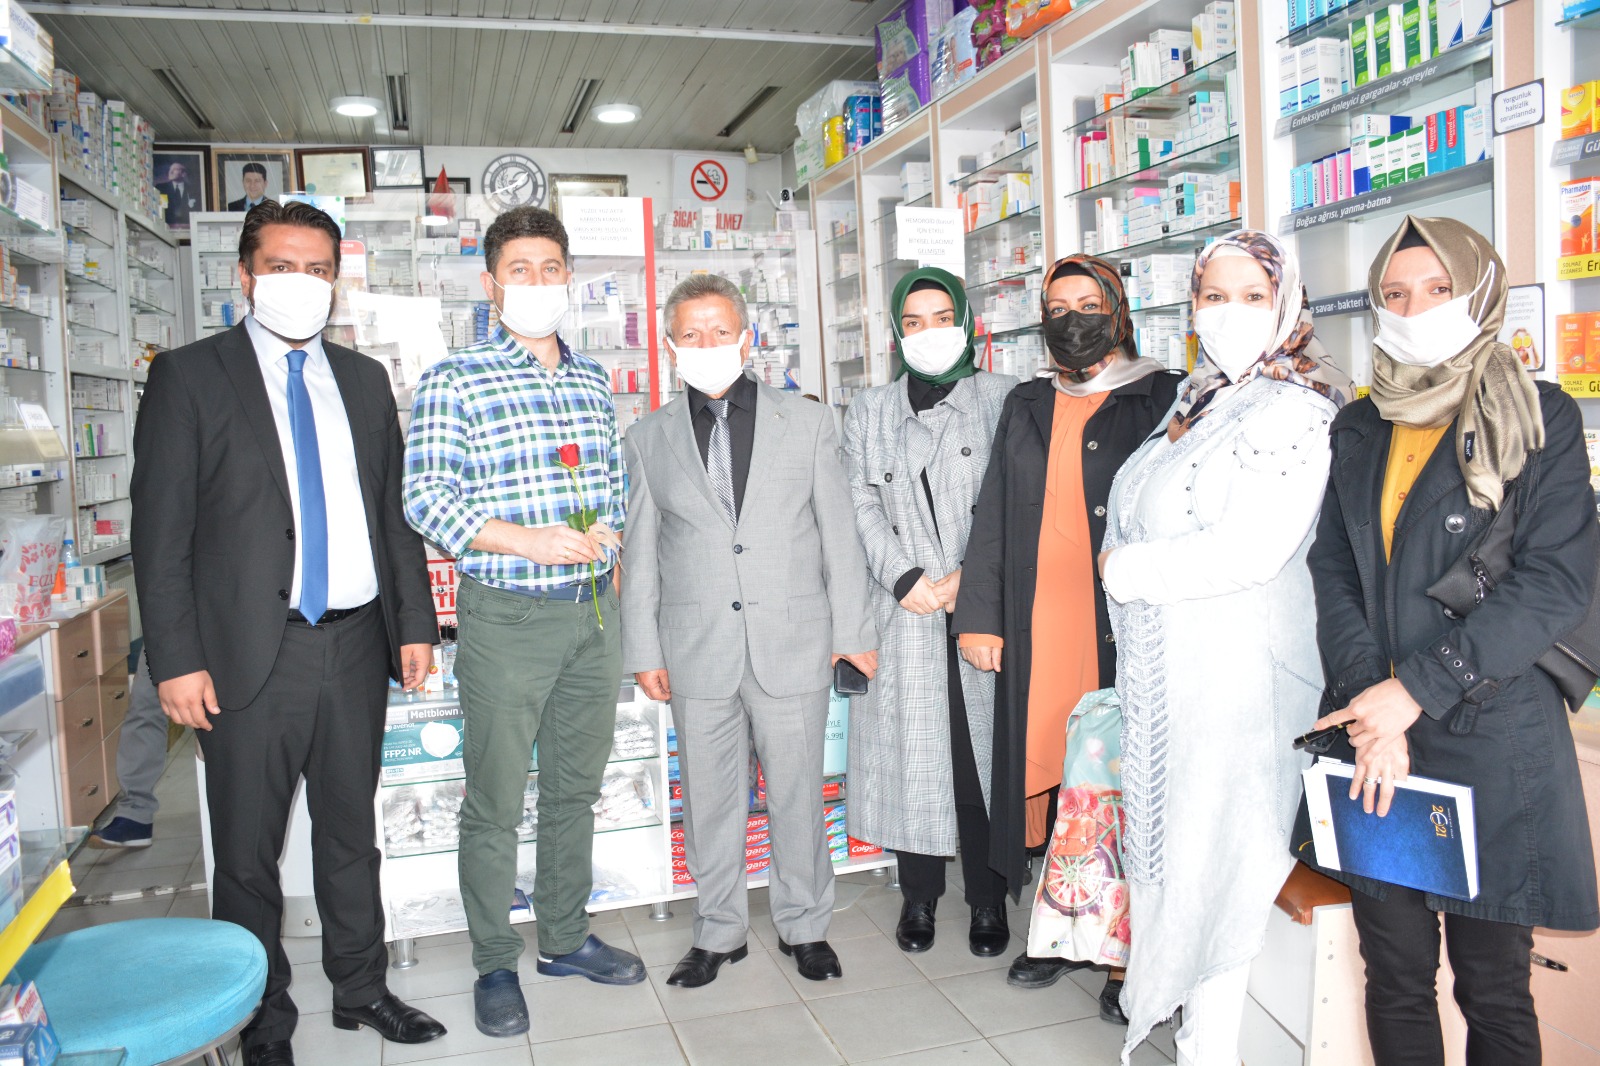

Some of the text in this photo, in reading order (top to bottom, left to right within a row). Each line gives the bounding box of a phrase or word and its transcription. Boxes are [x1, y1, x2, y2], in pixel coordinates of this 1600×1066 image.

[1292, 107, 1330, 128] Enfeksiyon
[1331, 94, 1359, 114] önleyici
[1359, 65, 1439, 103] gargaralar-spreyler
[1502, 90, 1532, 104] Yorgunluk
[1505, 101, 1529, 112] halsizlik
[1500, 108, 1536, 122] sorunlarında
[1561, 184, 1592, 195] Pharmaton
[1296, 215, 1317, 228] Boğaz
[1340, 195, 1392, 217] yanma-batma
[1337, 296, 1364, 311] bakteri
[410, 708, 459, 719] Meltblown
[384, 747, 422, 759] FFP2 NR
